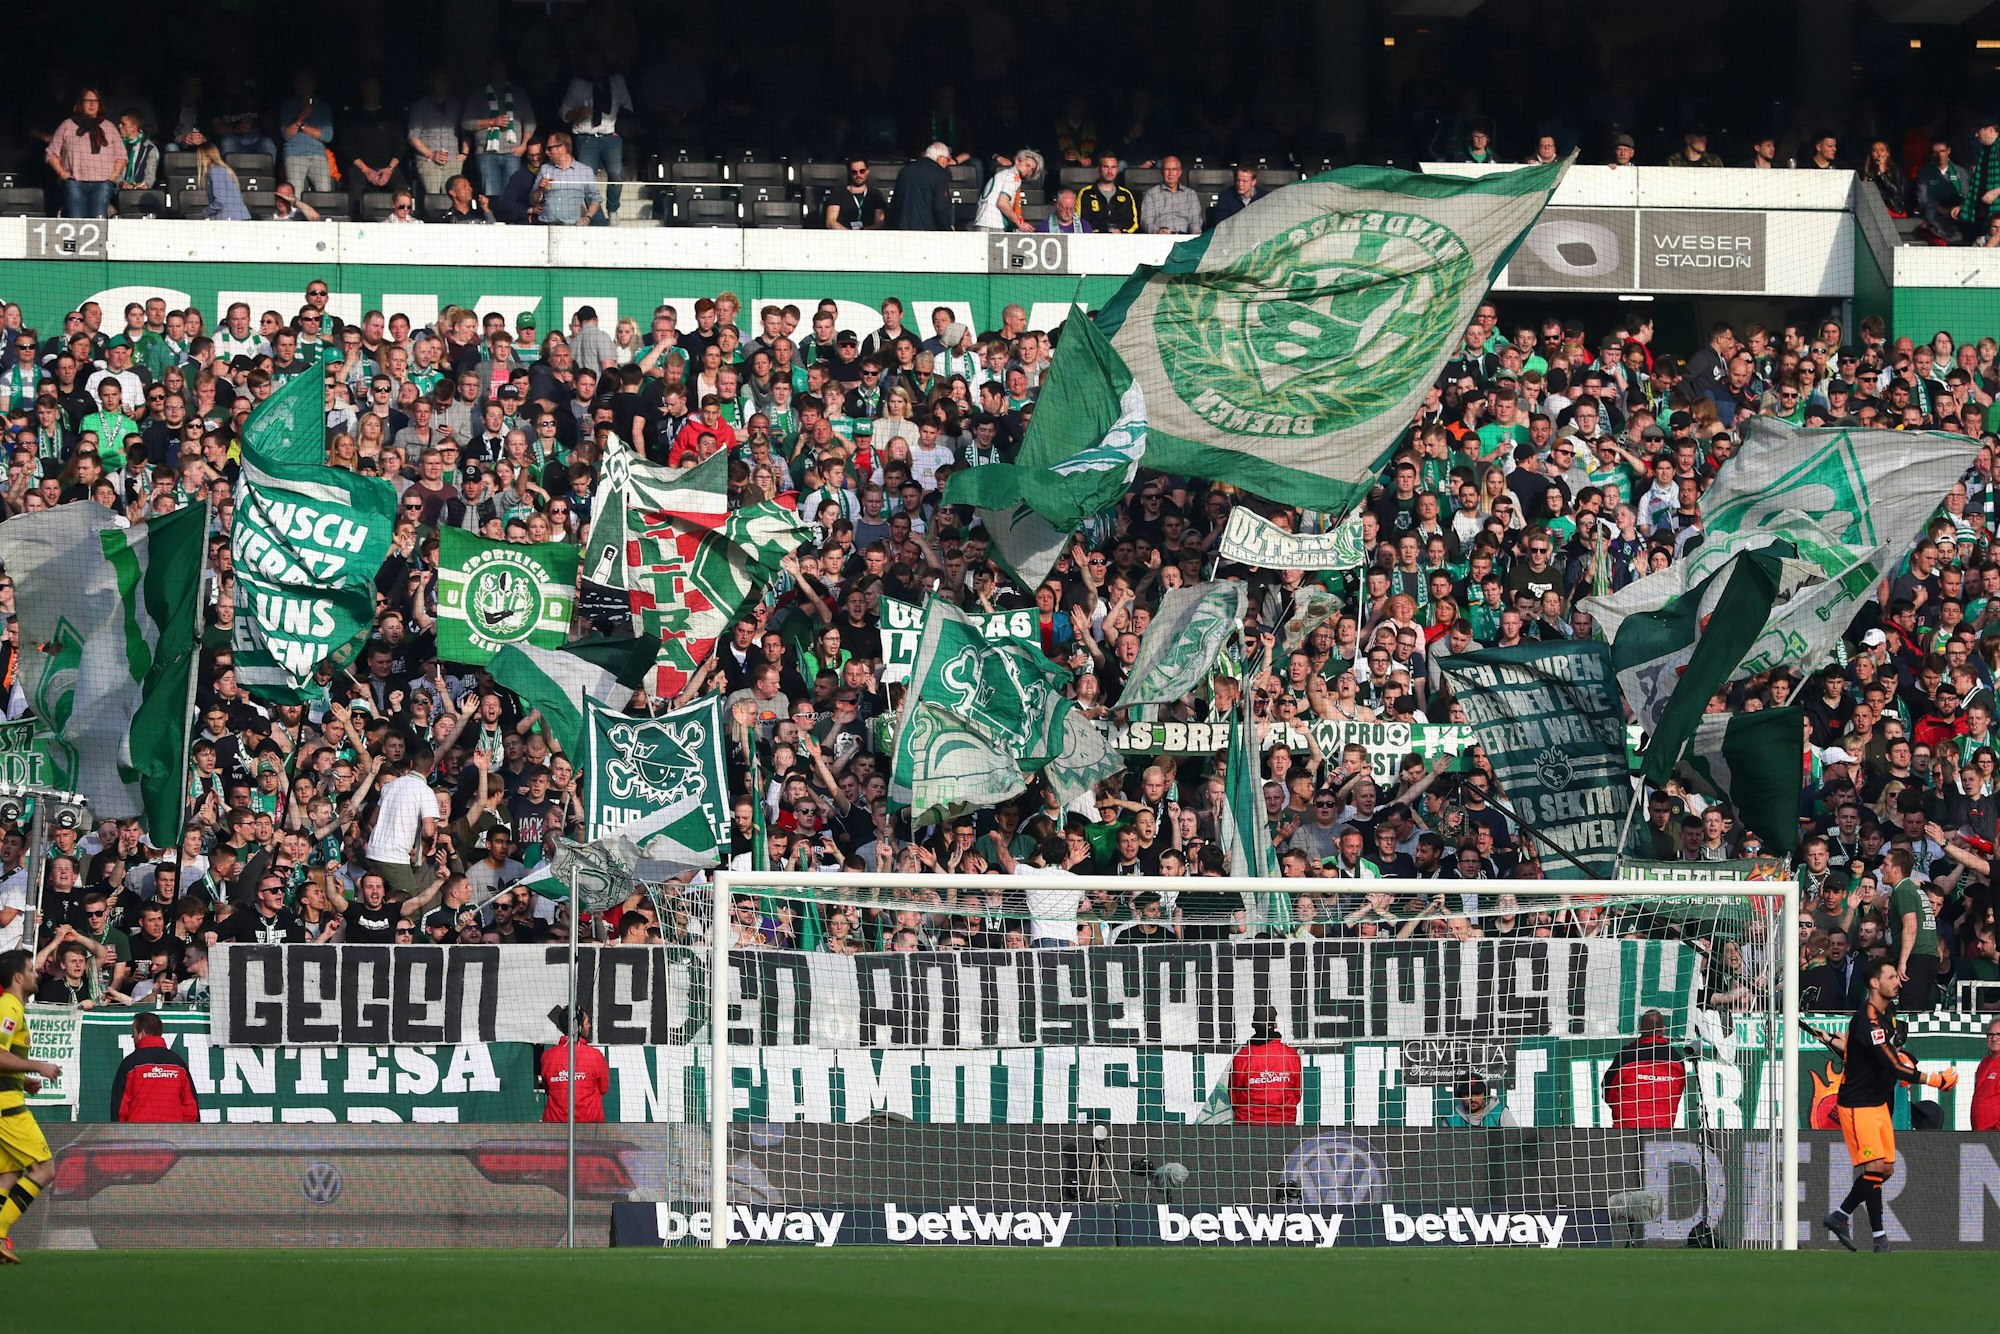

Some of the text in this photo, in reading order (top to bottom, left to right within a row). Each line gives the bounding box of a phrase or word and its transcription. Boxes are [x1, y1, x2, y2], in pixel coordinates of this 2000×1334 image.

[33, 222, 100, 255] 132
[995, 237, 1062, 270] 130
[1653, 235, 1751, 251] WESER
[1654, 253, 1751, 269] STADION
[462, 549, 550, 583] SPORTLICH
[256, 593, 335, 637] UNS
[1345, 723, 1385, 746] PRO
[228, 945, 500, 1044] GEGEN
[30, 1019, 76, 1032] MENSCH
[32, 1033, 72, 1045] GESETZ
[29, 1046, 74, 1059] VERBOT
[1637, 1074, 1676, 1082] SECURITY
[656, 1202, 845, 1247] betway
[884, 1203, 1072, 1248] betway
[1158, 1203, 1342, 1248] betway
[1382, 1203, 1568, 1248] betway
